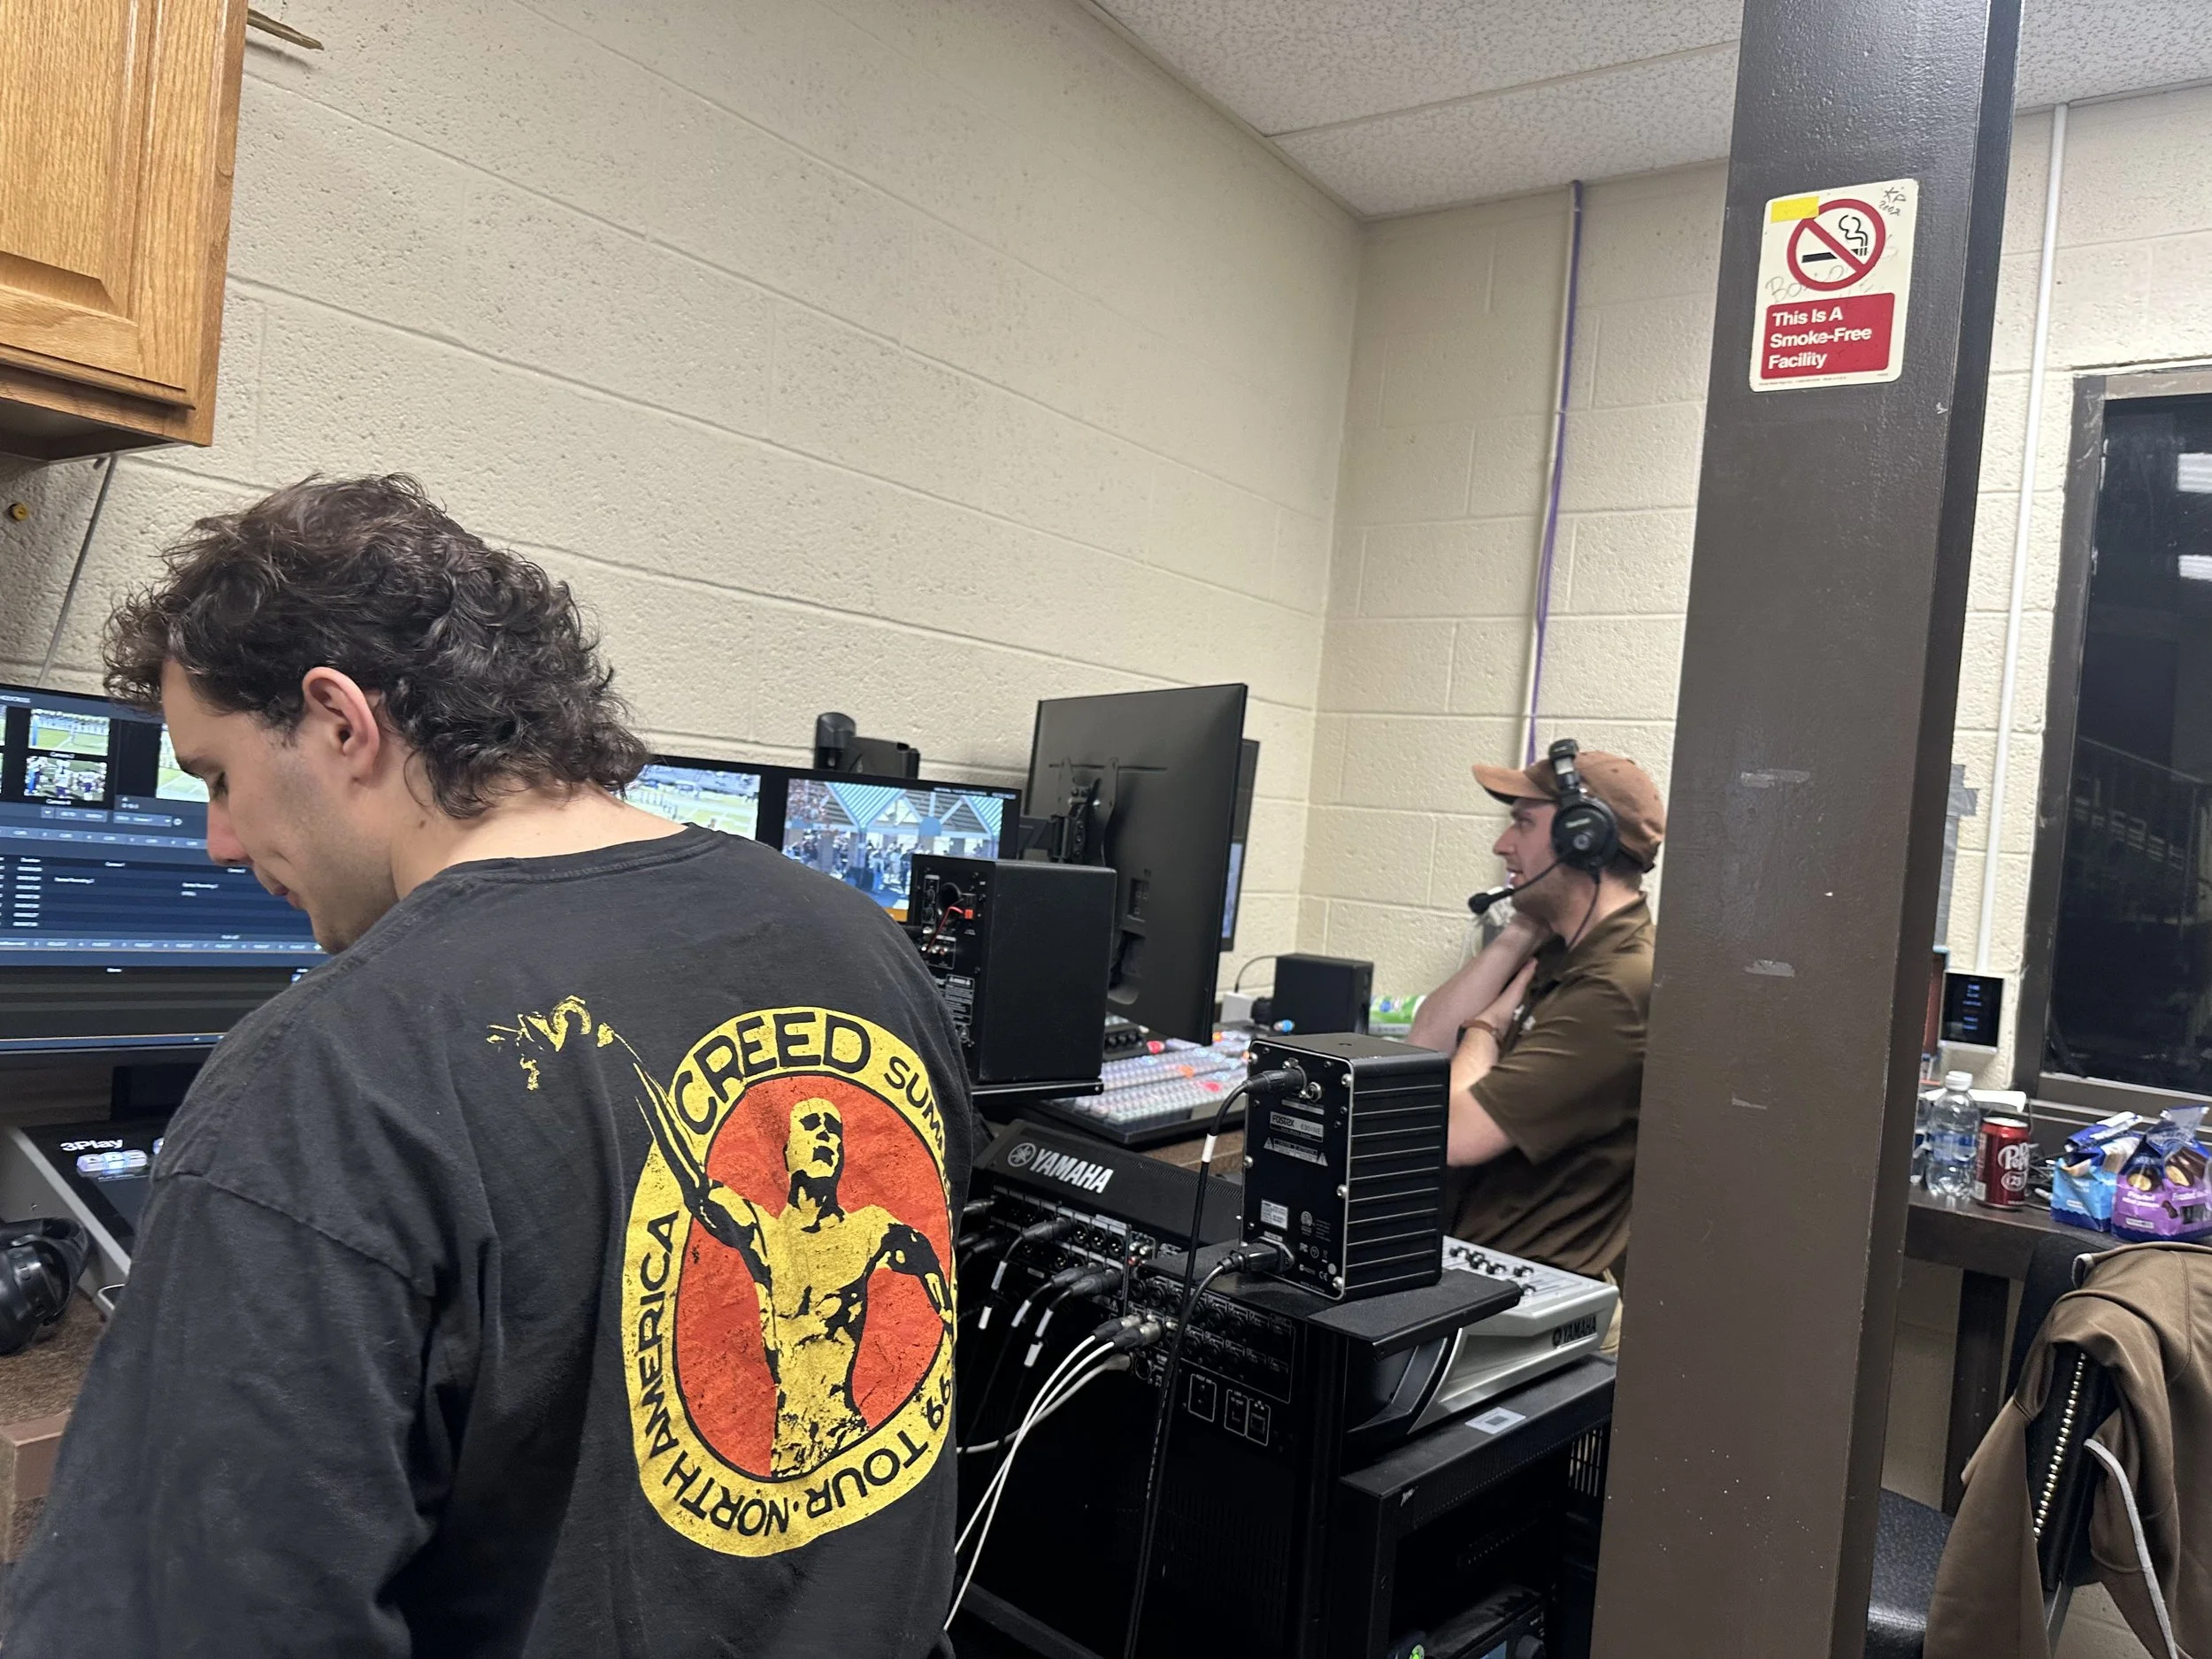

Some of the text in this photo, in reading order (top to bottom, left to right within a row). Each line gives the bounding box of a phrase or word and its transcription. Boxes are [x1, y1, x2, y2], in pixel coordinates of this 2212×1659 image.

[1772, 306, 1844, 327] This Is A
[1770, 326, 1872, 349] Smoke-Free
[1768, 353, 1828, 370] Facility
[675, 1011, 872, 1135] CREED
[60, 1139, 124, 1152] 3Play
[1029, 1148, 1114, 1194] YAMAHA
[638, 1210, 680, 1459] AMERICA
[662, 1450, 788, 1536] NORTH
